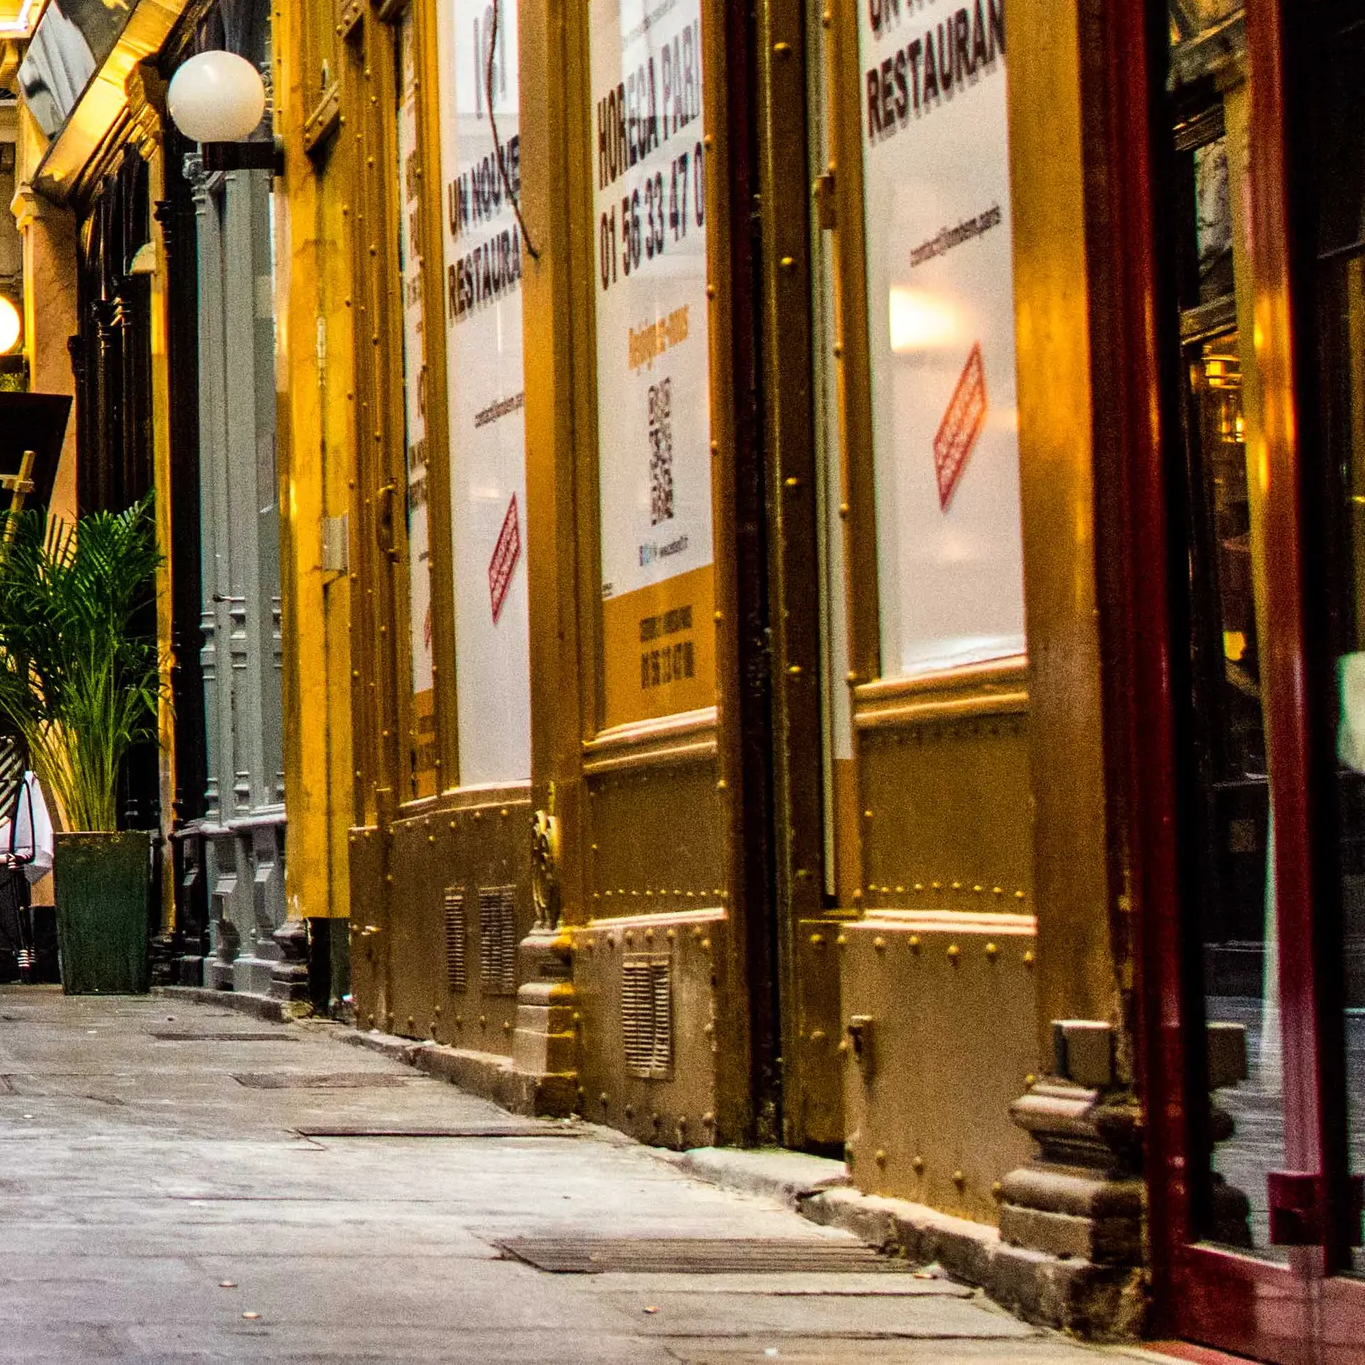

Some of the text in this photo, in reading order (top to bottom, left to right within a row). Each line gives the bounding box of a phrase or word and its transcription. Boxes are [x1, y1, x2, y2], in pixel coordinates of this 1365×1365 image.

[661, 18, 701, 142] PARI
[472, 134, 520, 224] NOUVE
[448, 223, 522, 322] RESTAURA
